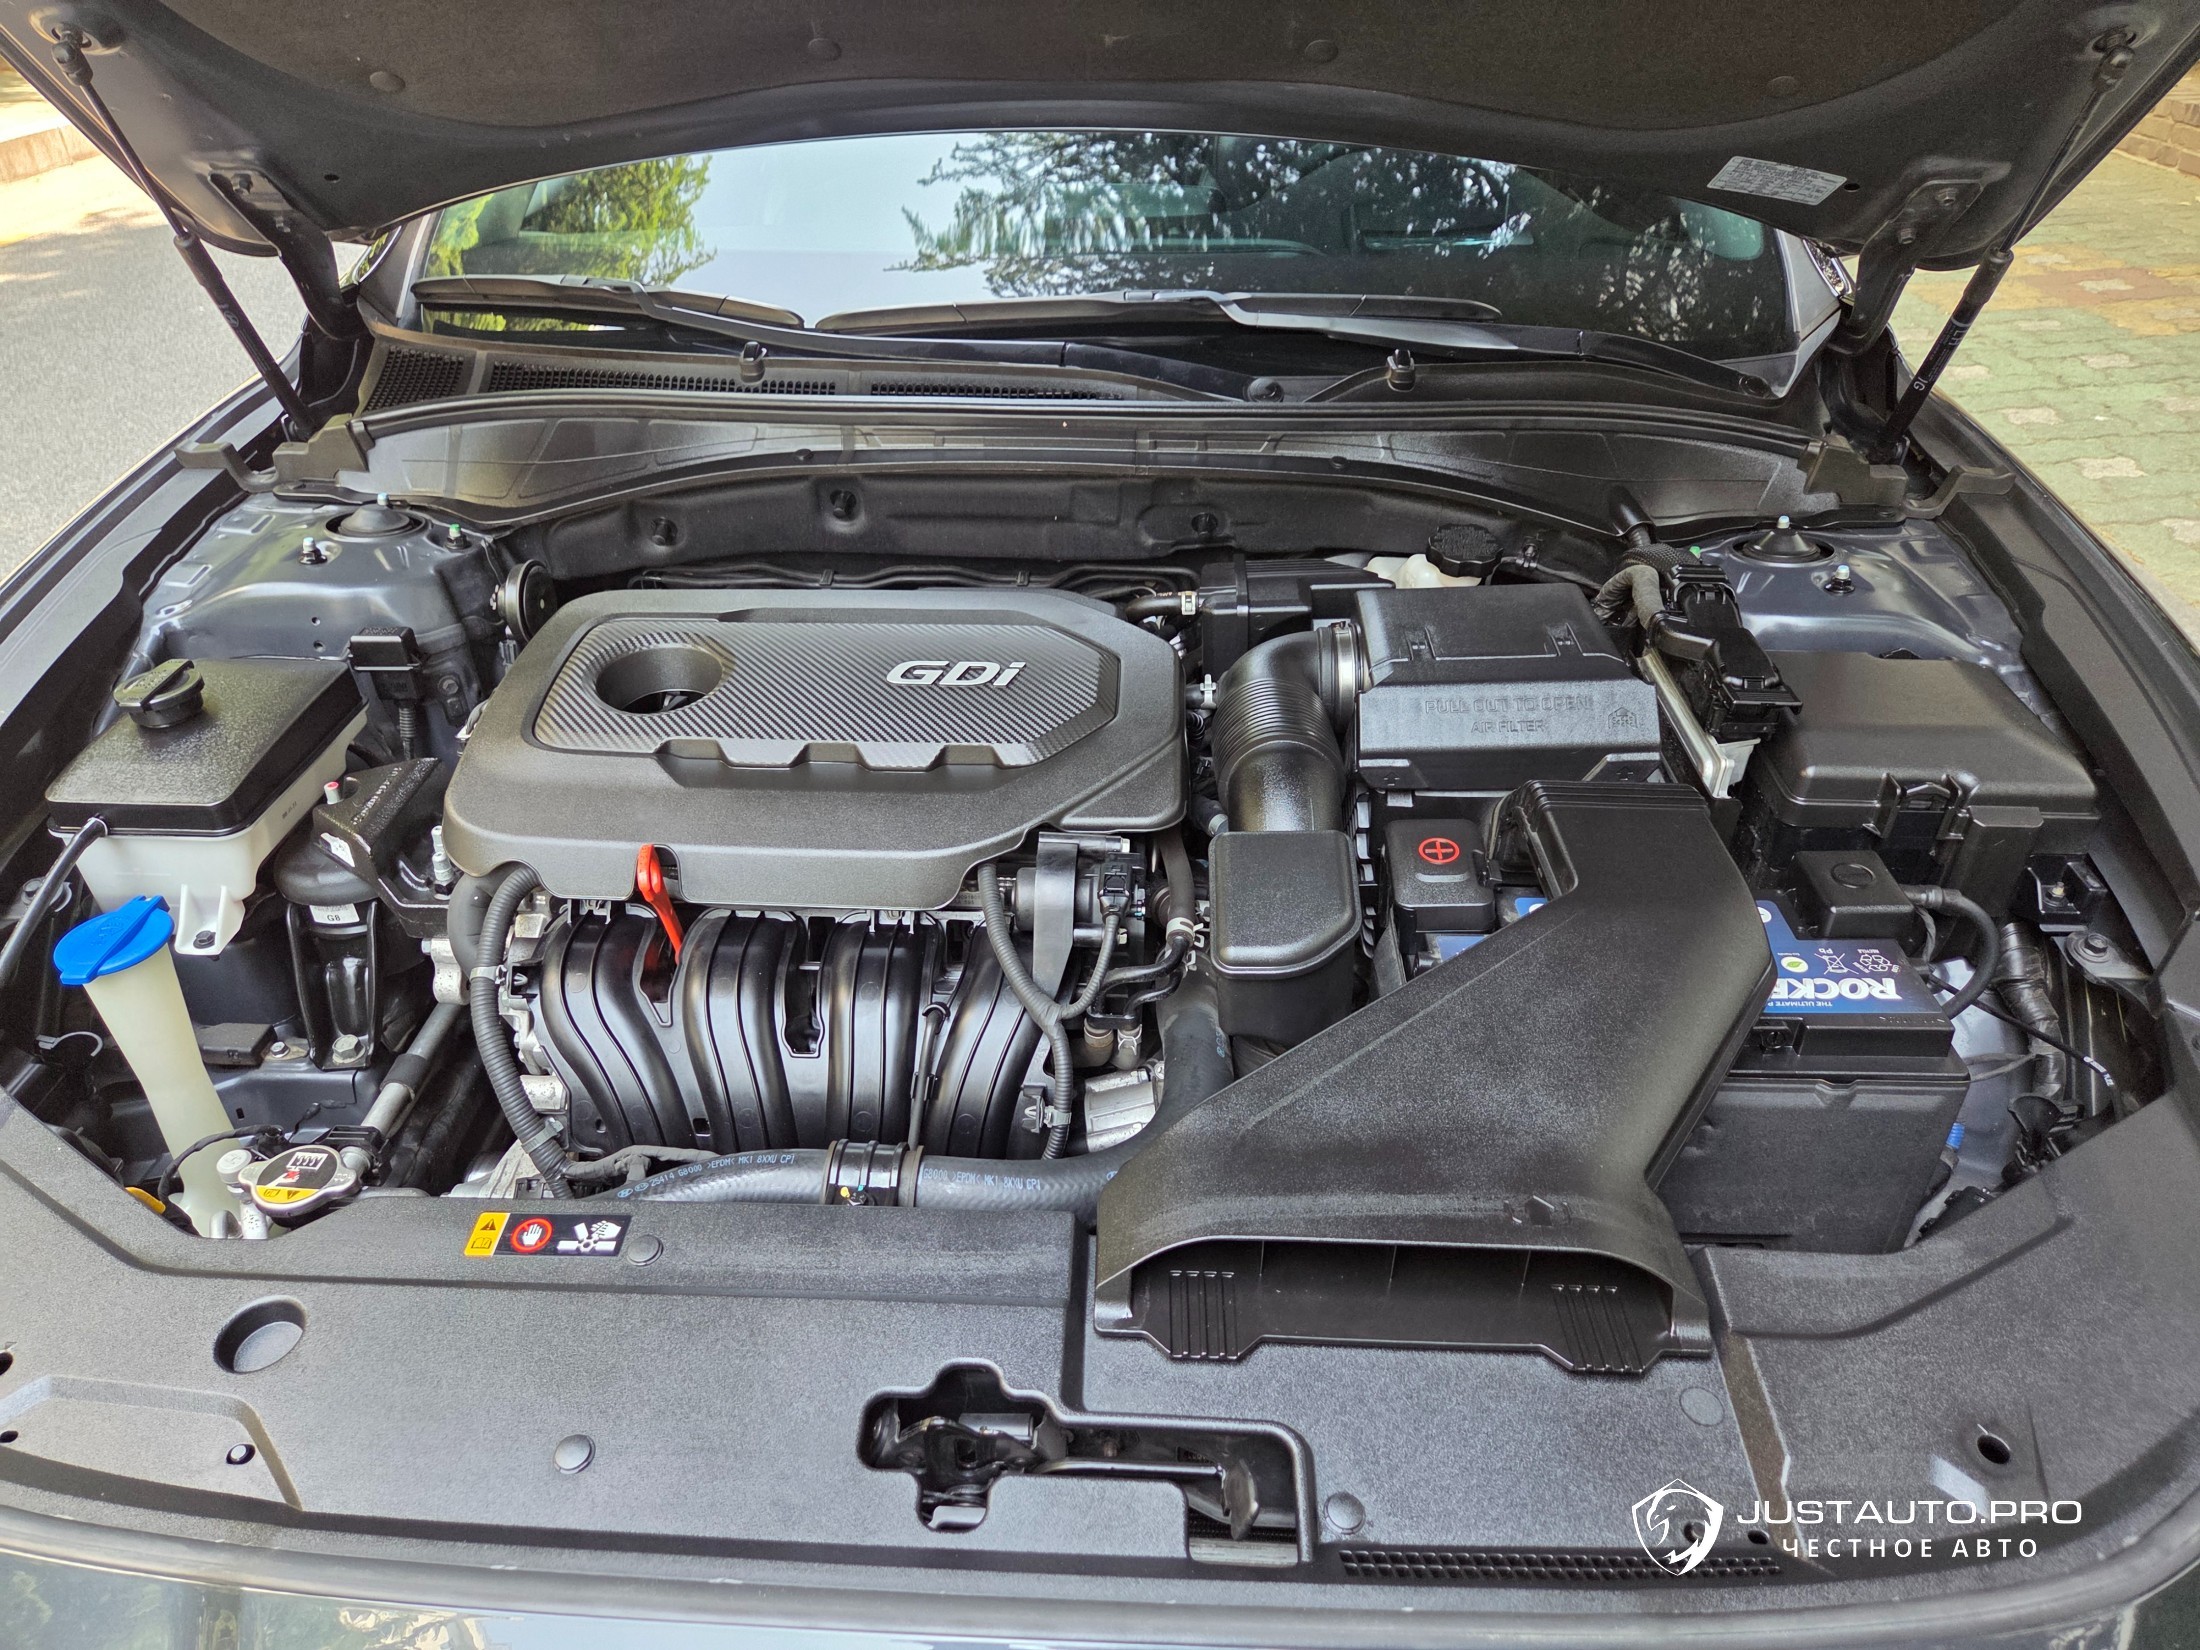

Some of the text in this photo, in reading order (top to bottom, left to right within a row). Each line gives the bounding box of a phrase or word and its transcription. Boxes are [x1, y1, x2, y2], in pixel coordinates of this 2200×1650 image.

[886, 660, 1027, 686] GDi
[1425, 695, 1592, 714] PULL OUT TO OPEN
[1470, 719, 1545, 733] AIR FILTER
[1770, 977, 1903, 1000] ROCKE
[650, 1172, 674, 1187] 25414
